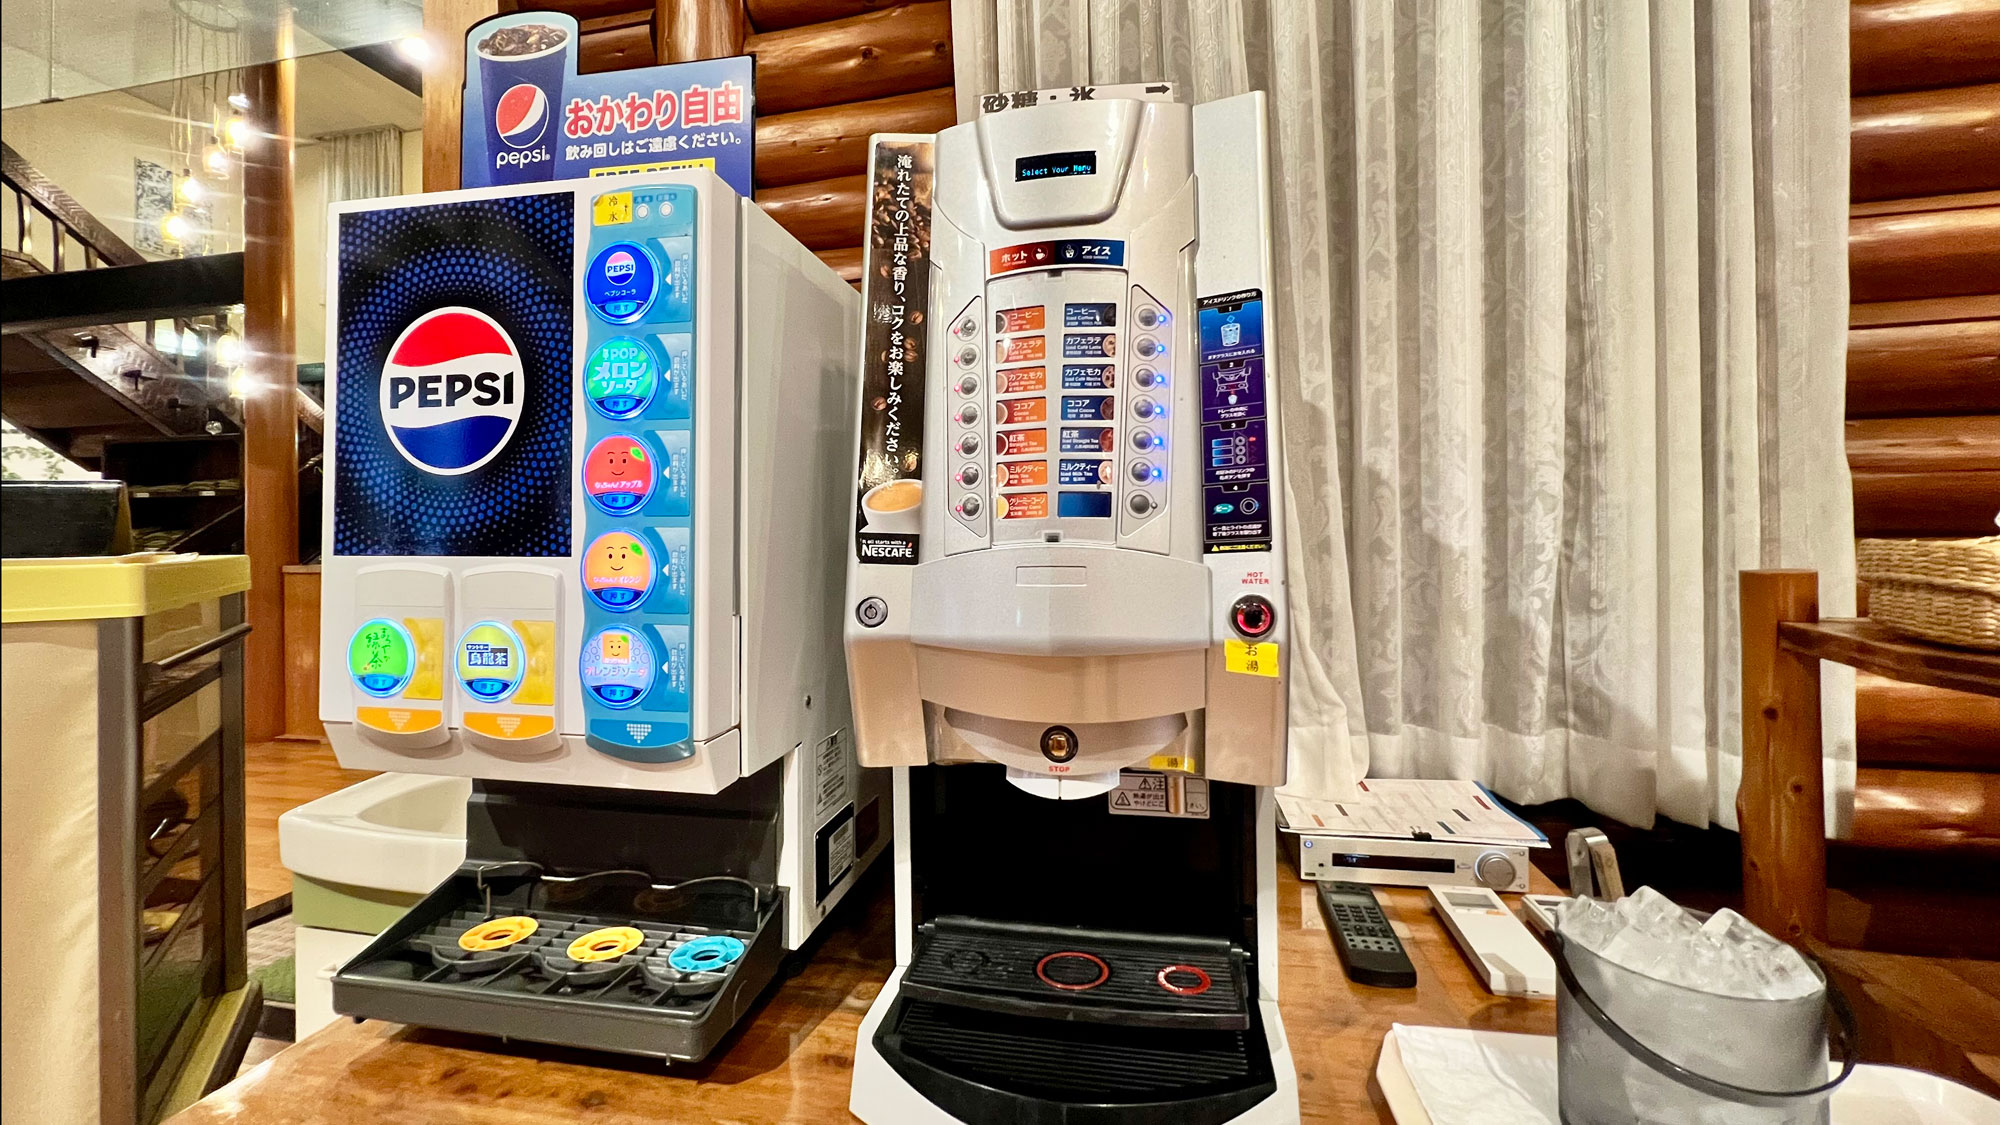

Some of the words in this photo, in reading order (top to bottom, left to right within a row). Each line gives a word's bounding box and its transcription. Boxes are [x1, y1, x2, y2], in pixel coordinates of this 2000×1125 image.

[566, 81, 743, 138] おかわり自由
[565, 131, 742, 161] 飲み回しはご遠慮ください。
[496, 146, 546, 168] pepsi
[1021, 169, 1048, 177] Select
[1052, 166, 1068, 174] Your
[1073, 164, 1091, 173] Menu
[1082, 245, 1111, 255] アイス
[1001, 250, 1028, 263] ホット
[607, 264, 634, 273] PEPSI
[1010, 311, 1040, 320] コーヒー
[1066, 337, 1102, 345] カフェラテ
[610, 348, 639, 360] POP
[593, 361, 647, 380] メロン
[1009, 371, 1043, 381] カフェモカ
[1065, 368, 1101, 376] カフェモカ
[390, 370, 514, 409] PEPSI
[601, 377, 643, 395] ソーダ
[1013, 402, 1036, 410] ココア
[1067, 399, 1090, 407] ココア
[1009, 434, 1025, 442] 紅茶
[1062, 430, 1079, 438] 紅茶
[1010, 465, 1045, 473] ミルクティー
[1060, 463, 1098, 471] ミルクティー
[470, 652, 507, 665] 烏龍茶
[1245, 644, 1259, 672] お湯
[585, 666, 647, 678] オレンジソーダ
